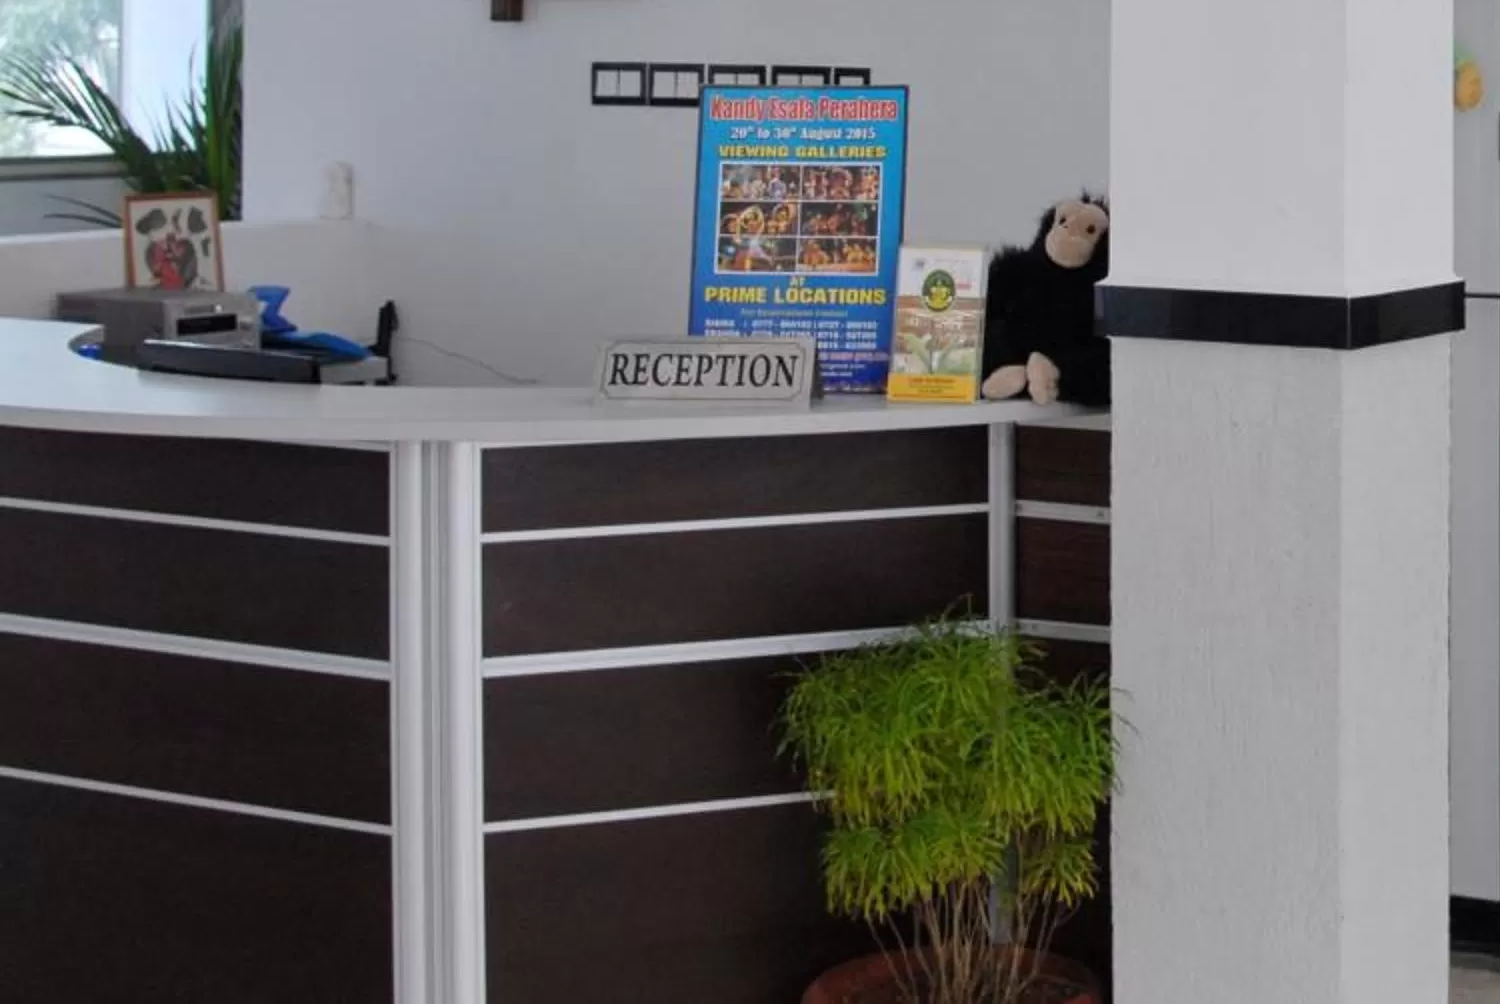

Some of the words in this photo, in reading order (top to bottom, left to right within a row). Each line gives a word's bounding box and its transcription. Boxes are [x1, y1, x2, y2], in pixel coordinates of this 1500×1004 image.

[711, 96, 764, 122] Kandy
[768, 96, 814, 120] Esala
[818, 96, 898, 120] Perahera
[799, 127, 841, 141] August
[845, 127, 876, 140] 2015
[719, 145, 789, 157] VIEWING
[795, 146, 887, 158] GALLERIES
[790, 276, 806, 286] AT
[704, 287, 767, 303] PRIME
[774, 288, 886, 304] LOCATIONS
[607, 353, 800, 387] RECEPTION
